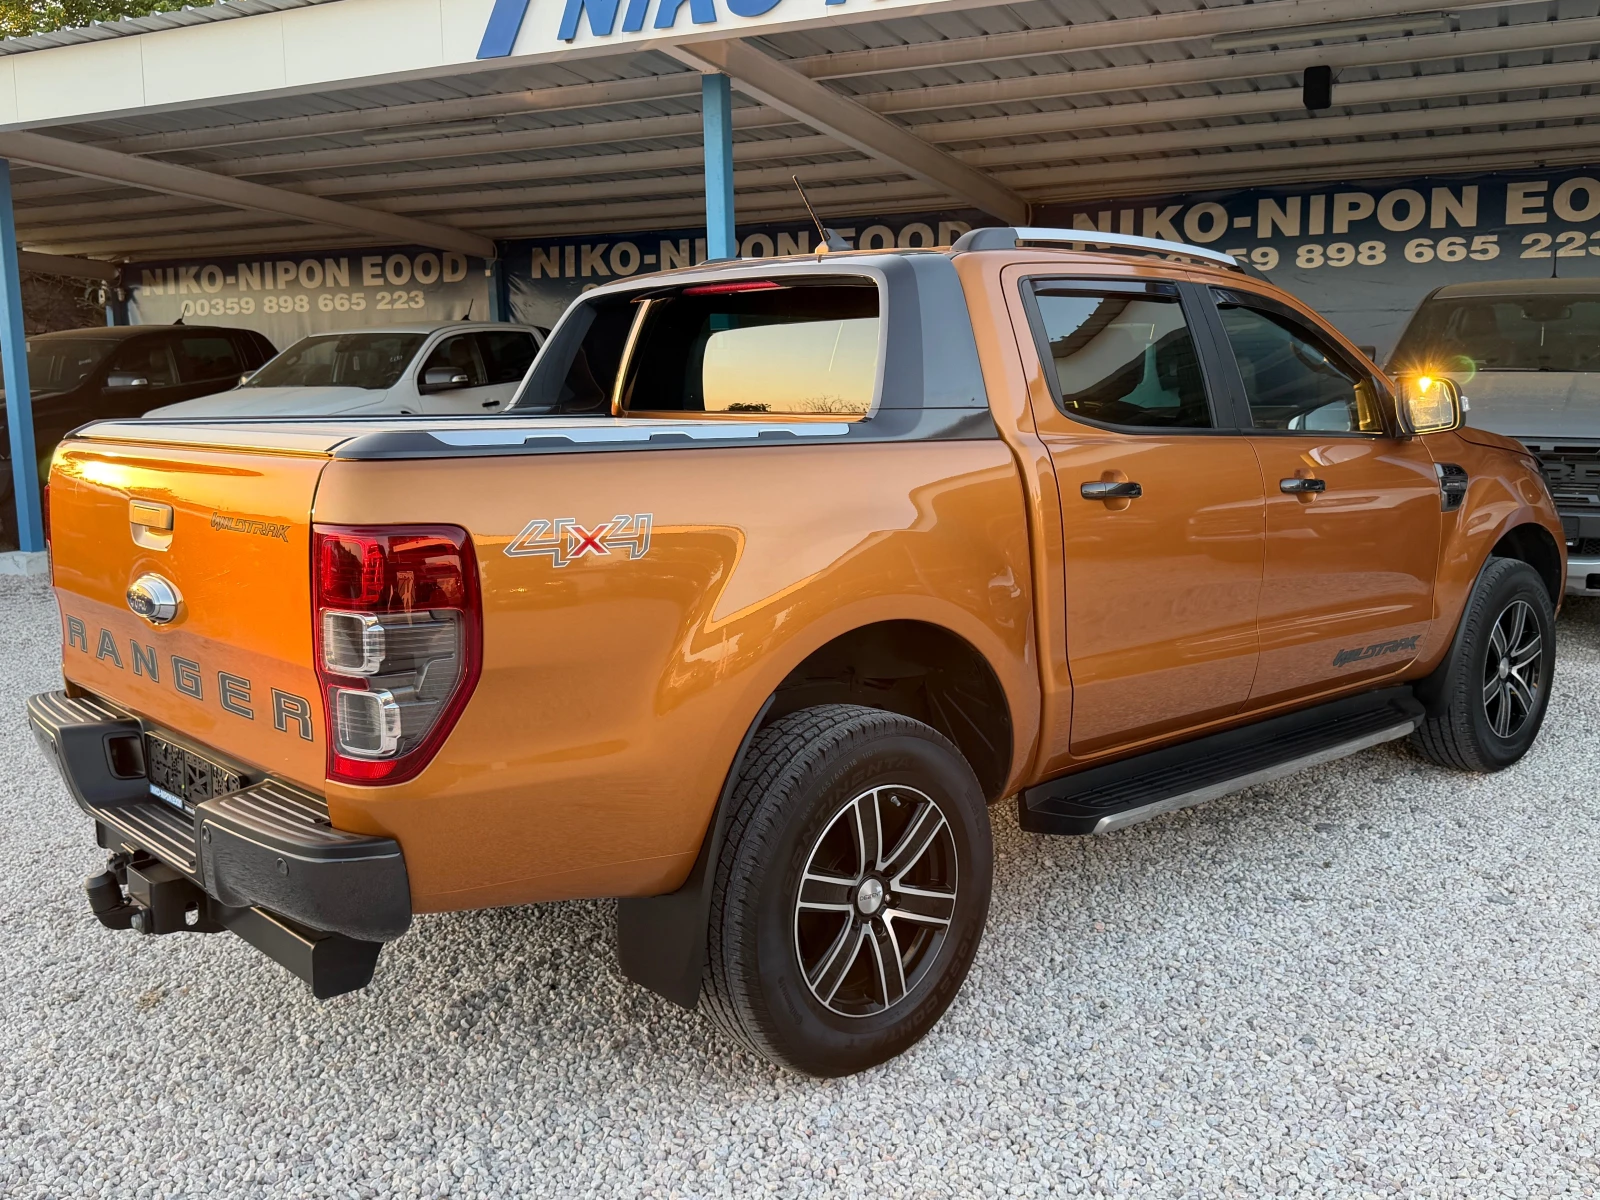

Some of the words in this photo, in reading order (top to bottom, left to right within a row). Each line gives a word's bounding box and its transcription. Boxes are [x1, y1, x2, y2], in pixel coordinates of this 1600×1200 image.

[1073, 185, 1479, 251] NIKO-NIPON
[531, 231, 810, 280] NIKO-NION
[1295, 240, 1387, 269] 898
[1404, 234, 1501, 264] 665
[141, 258, 350, 296] NIKO-NIPON
[361, 252, 468, 287] EOOD
[181, 297, 256, 317] 00359
[263, 294, 310, 314] 898
[318, 292, 367, 312] 665
[376, 290, 426, 310] 223
[210, 511, 291, 543] WILDTRAK
[1332, 634, 1422, 668] WILDTRAK
[65, 613, 314, 742] RANGER
